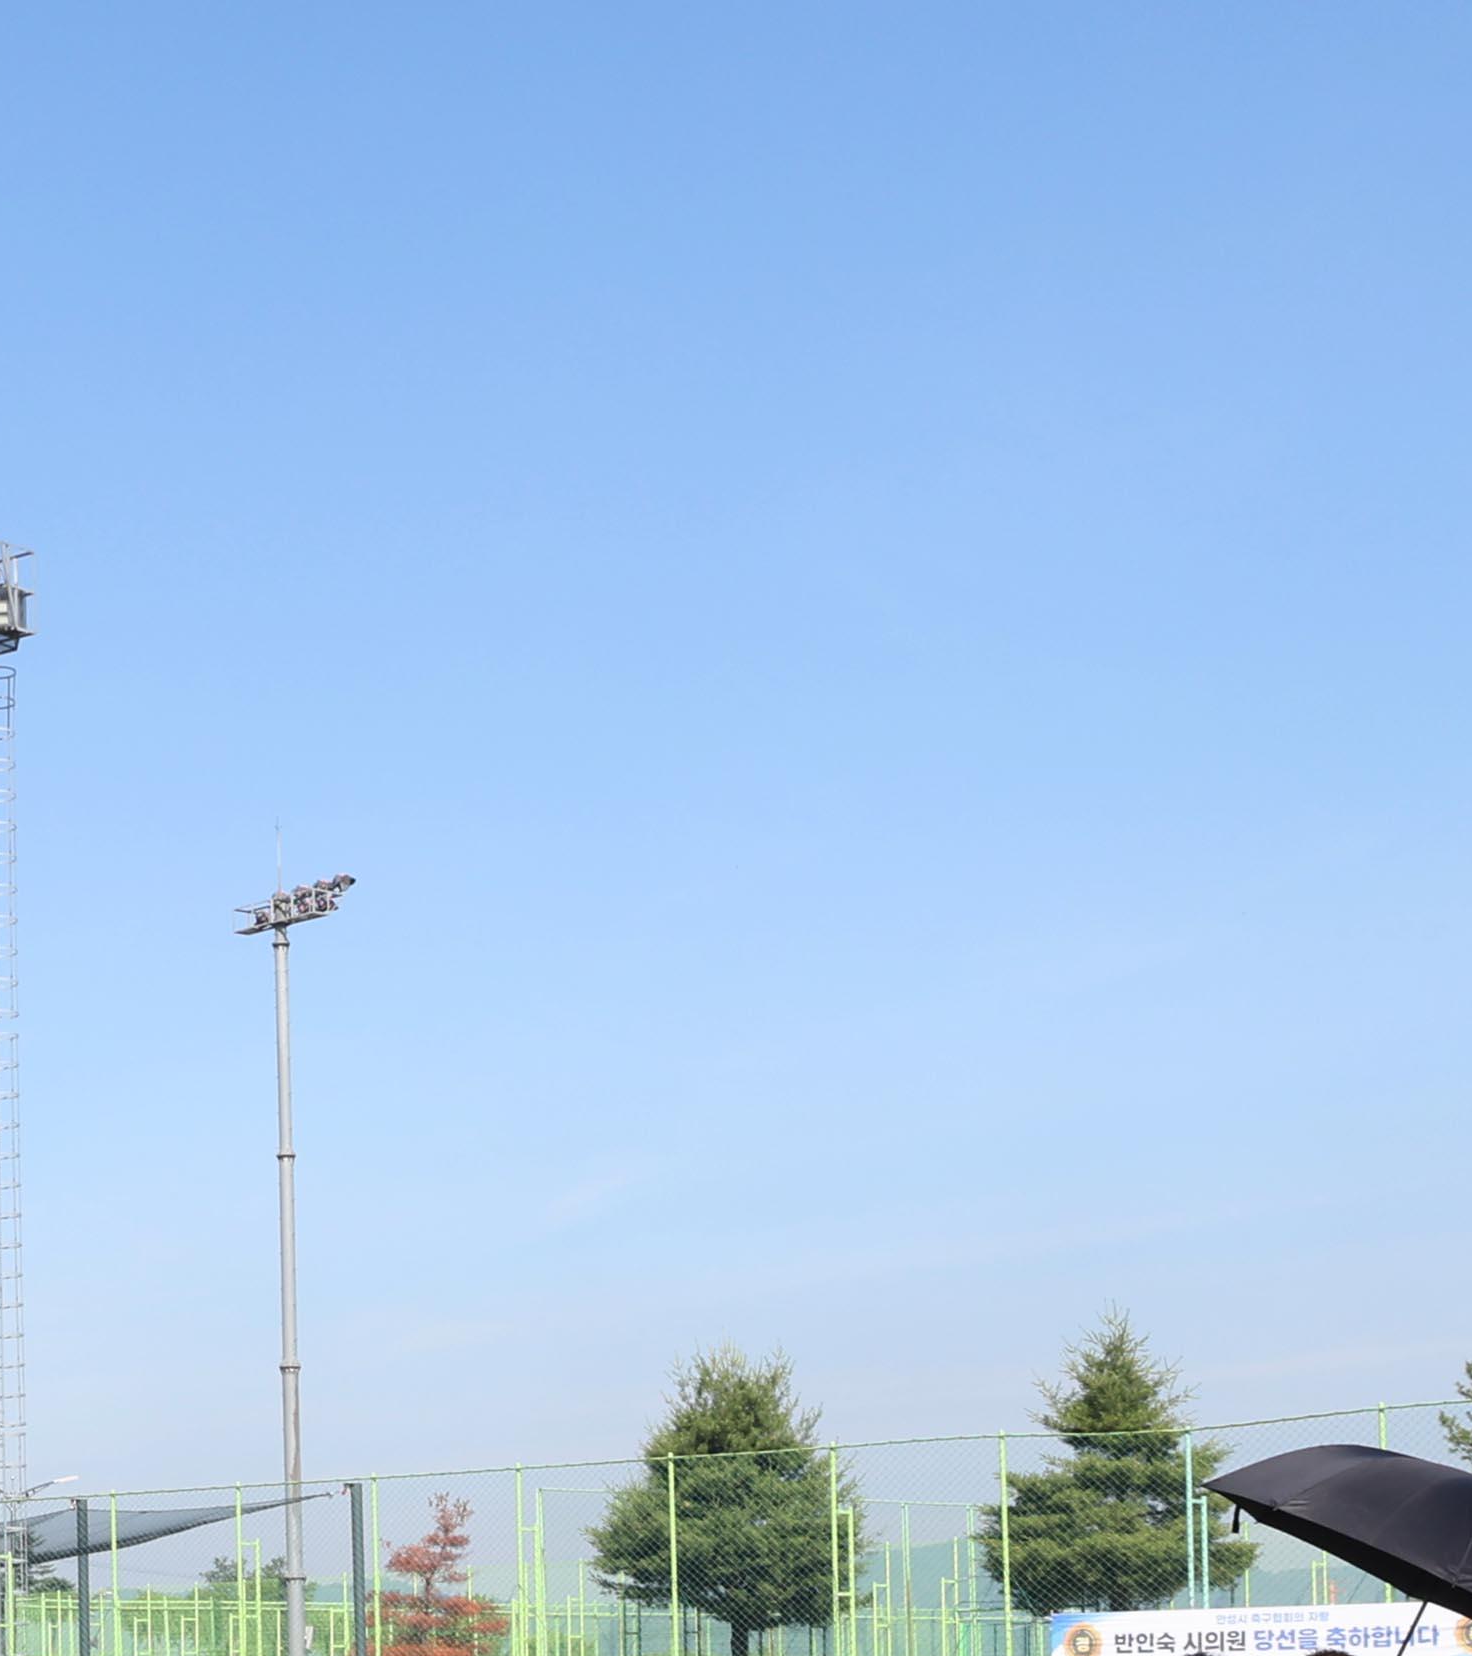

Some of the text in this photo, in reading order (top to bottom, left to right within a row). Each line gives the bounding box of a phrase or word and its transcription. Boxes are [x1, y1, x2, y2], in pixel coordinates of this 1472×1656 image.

[1308, 1611, 1330, 1622] 자랑
[1114, 1624, 1440, 1654] 반인숙 시의원 당선을 축하합니다
